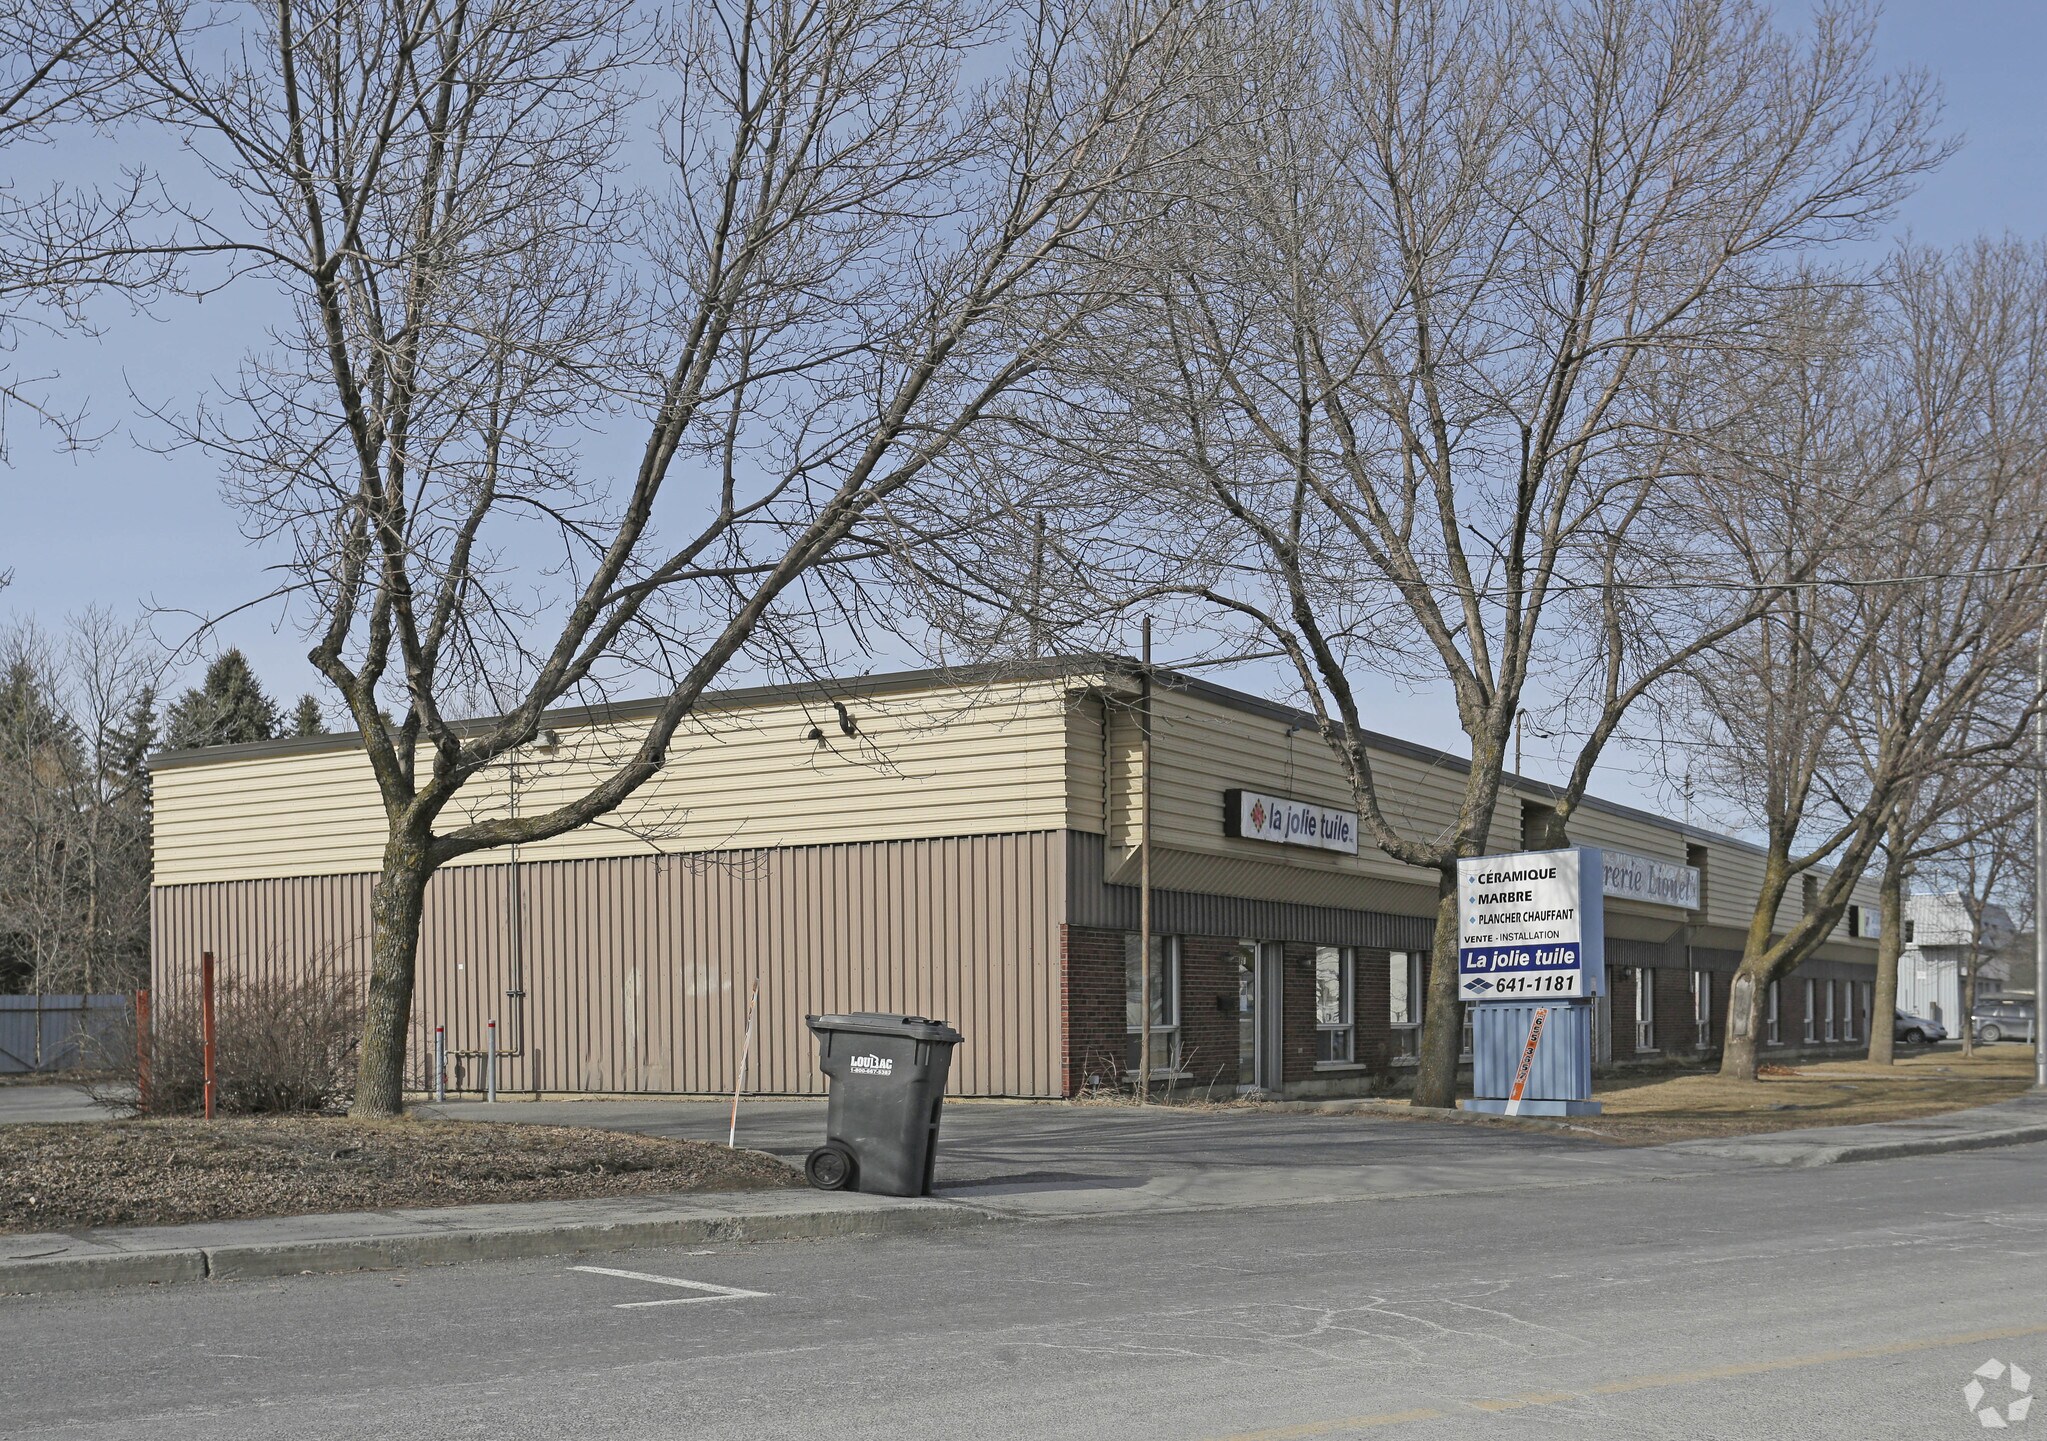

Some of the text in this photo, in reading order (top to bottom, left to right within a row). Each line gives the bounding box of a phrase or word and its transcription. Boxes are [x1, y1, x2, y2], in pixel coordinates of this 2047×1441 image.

[1269, 803, 1349, 843] la jolie tuile
[1478, 867, 1557, 885] CÉRAMIQUE
[1478, 890, 1533, 905] MARBRE
[1478, 908, 1574, 925] PLANCHER CHAUFFANT
[1464, 934, 1493, 943] VENTE
[1499, 930, 1560, 942] INSTALLATION
[1466, 948, 1575, 971] La jolie tuile
[1496, 975, 1574, 993] 641-1181
